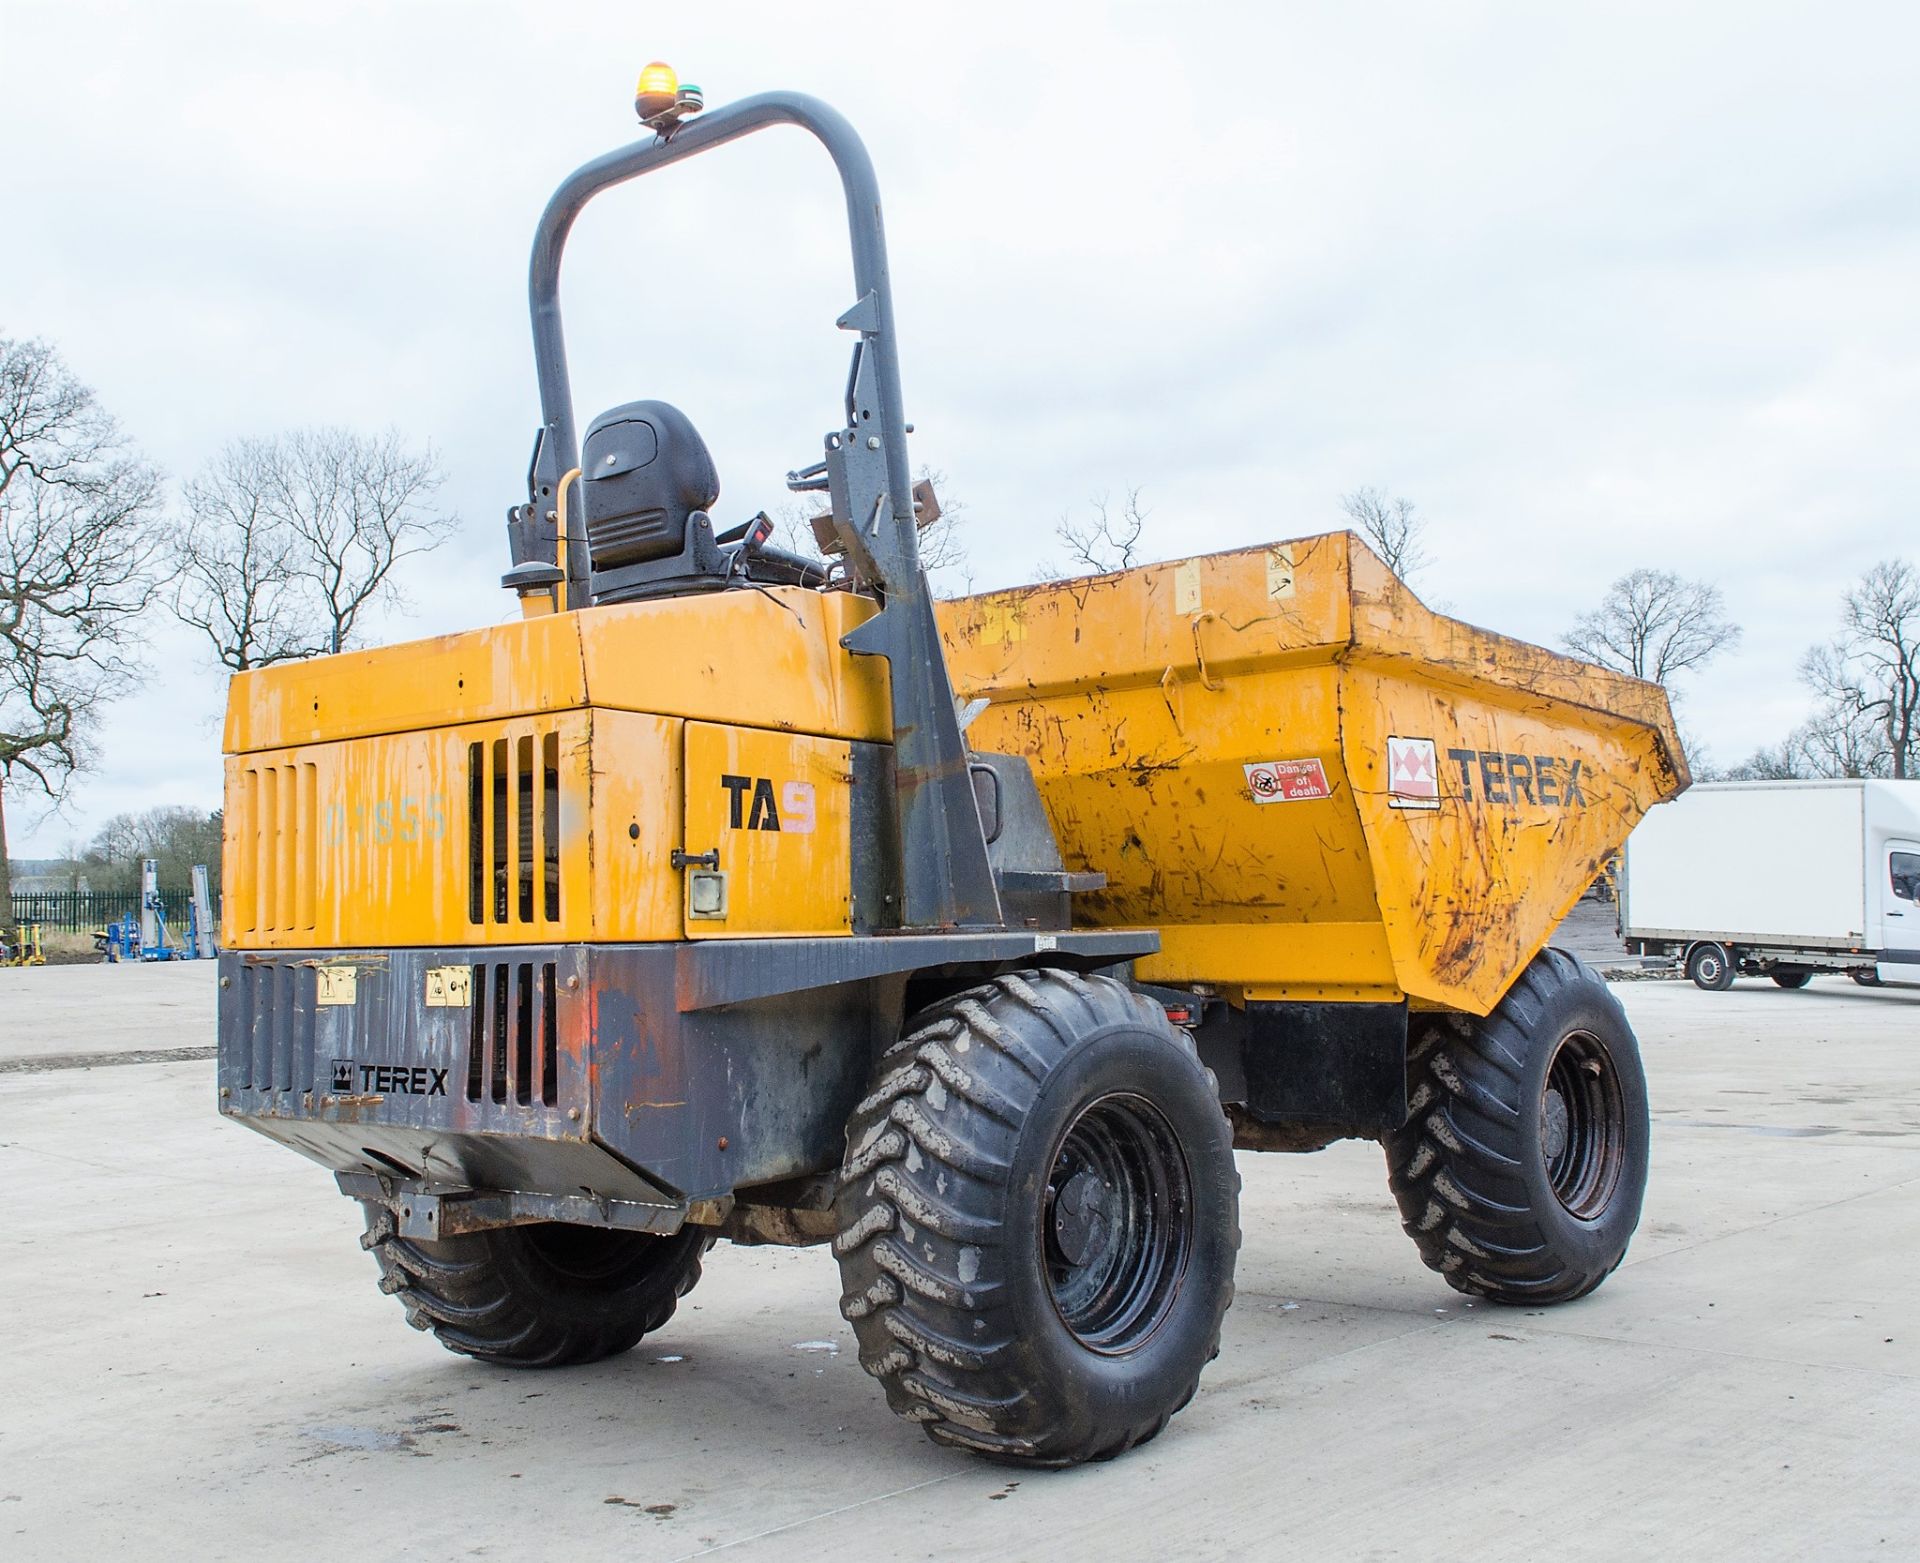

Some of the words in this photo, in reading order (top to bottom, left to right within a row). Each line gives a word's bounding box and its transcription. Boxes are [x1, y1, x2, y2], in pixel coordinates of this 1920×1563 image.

[1277, 763, 1317, 775] Danger
[1448, 749, 1587, 808] TEREX
[1289, 785, 1322, 797] death
[1296, 775, 1308, 786] of
[721, 774, 816, 834] TA9
[359, 1065, 449, 1096] TEREX
